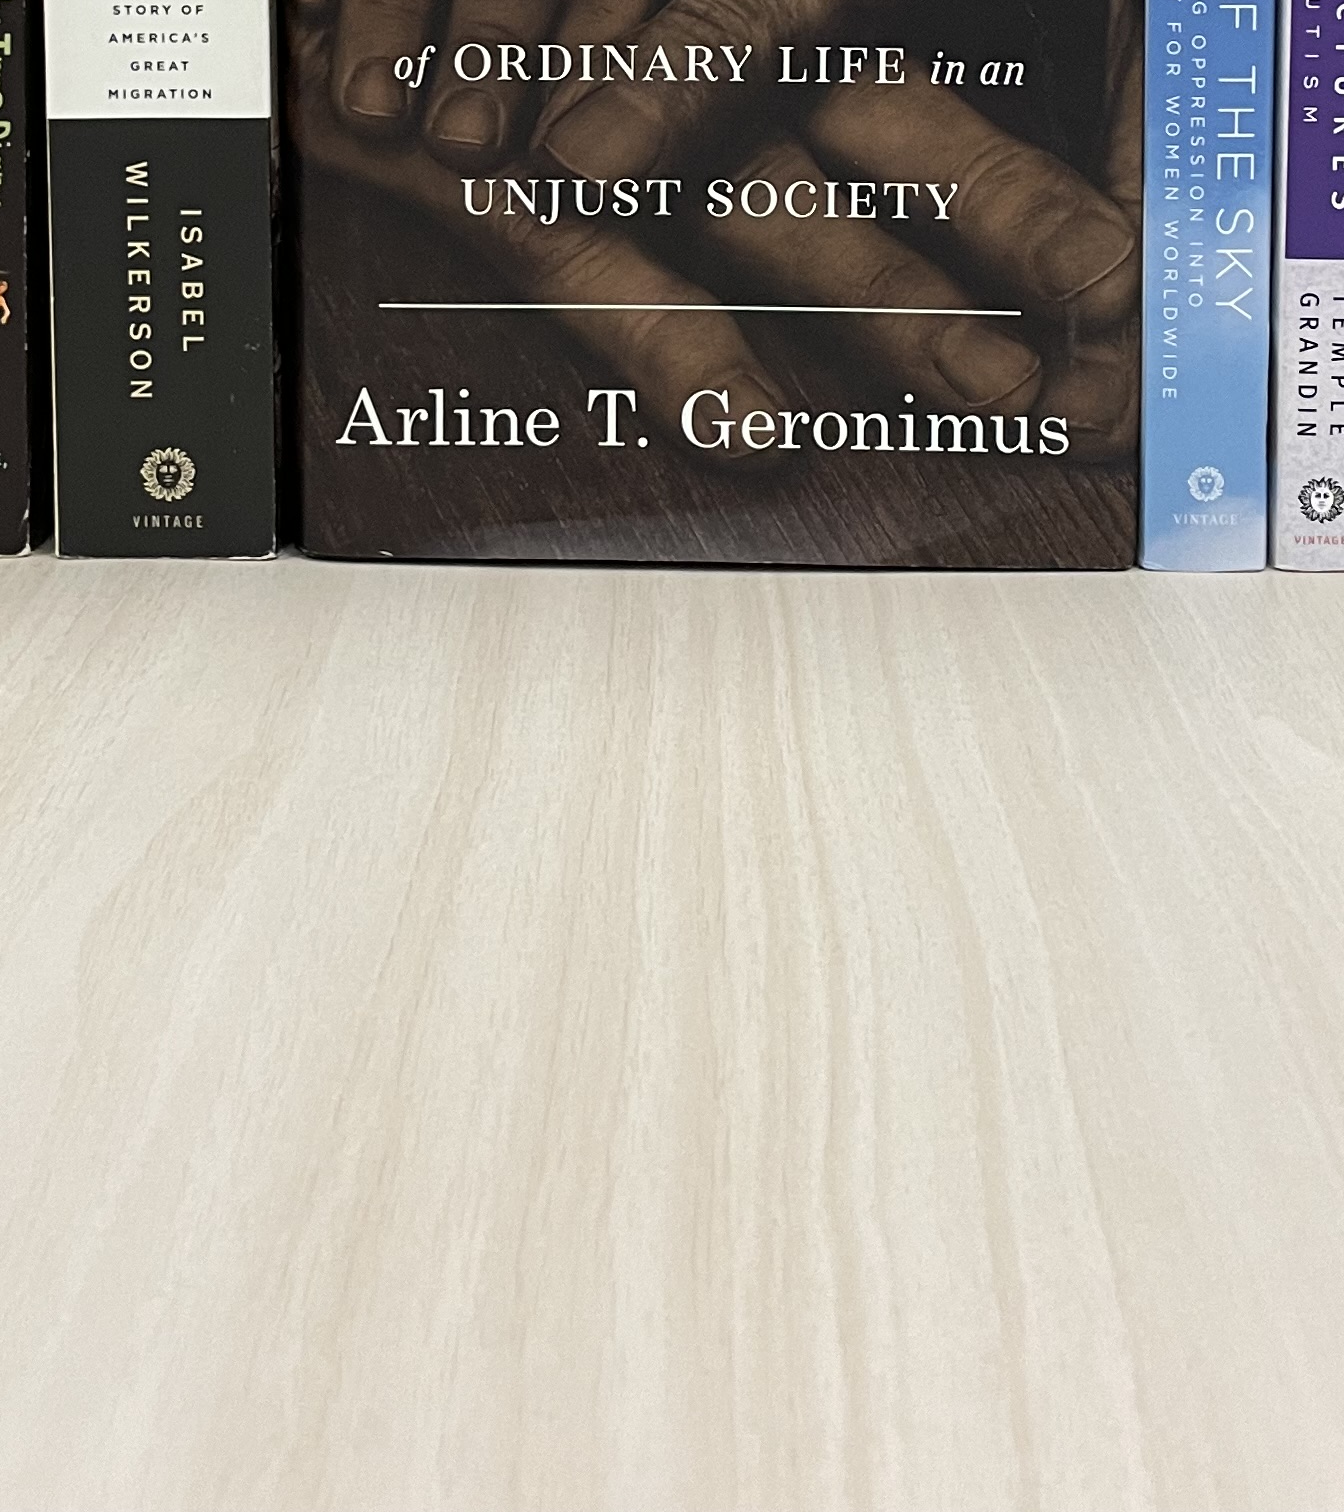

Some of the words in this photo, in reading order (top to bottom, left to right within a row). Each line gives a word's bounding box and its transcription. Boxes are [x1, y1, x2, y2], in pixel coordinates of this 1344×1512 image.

[108, 33, 210, 44] AMERICA'S
[130, 60, 190, 72] GREAT
[108, 88, 213, 100] MIGRATION
[1216, 65, 1256, 180] THE
[460, 178, 683, 226] UNJUST
[706, 180, 961, 221] SOCIETY
[125, 161, 153, 398] WILKERSON
[180, 209, 205, 352] ISABEL
[1215, 208, 1255, 321] SKY
[1297, 292, 1320, 437] GRANDIN
[335, 387, 561, 448] Arline
[586, 390, 650, 449] T.
[680, 390, 1071, 456] Geronimus
[132, 515, 204, 529] VINTAGE
[1173, 513, 1238, 526] VINTAGE
